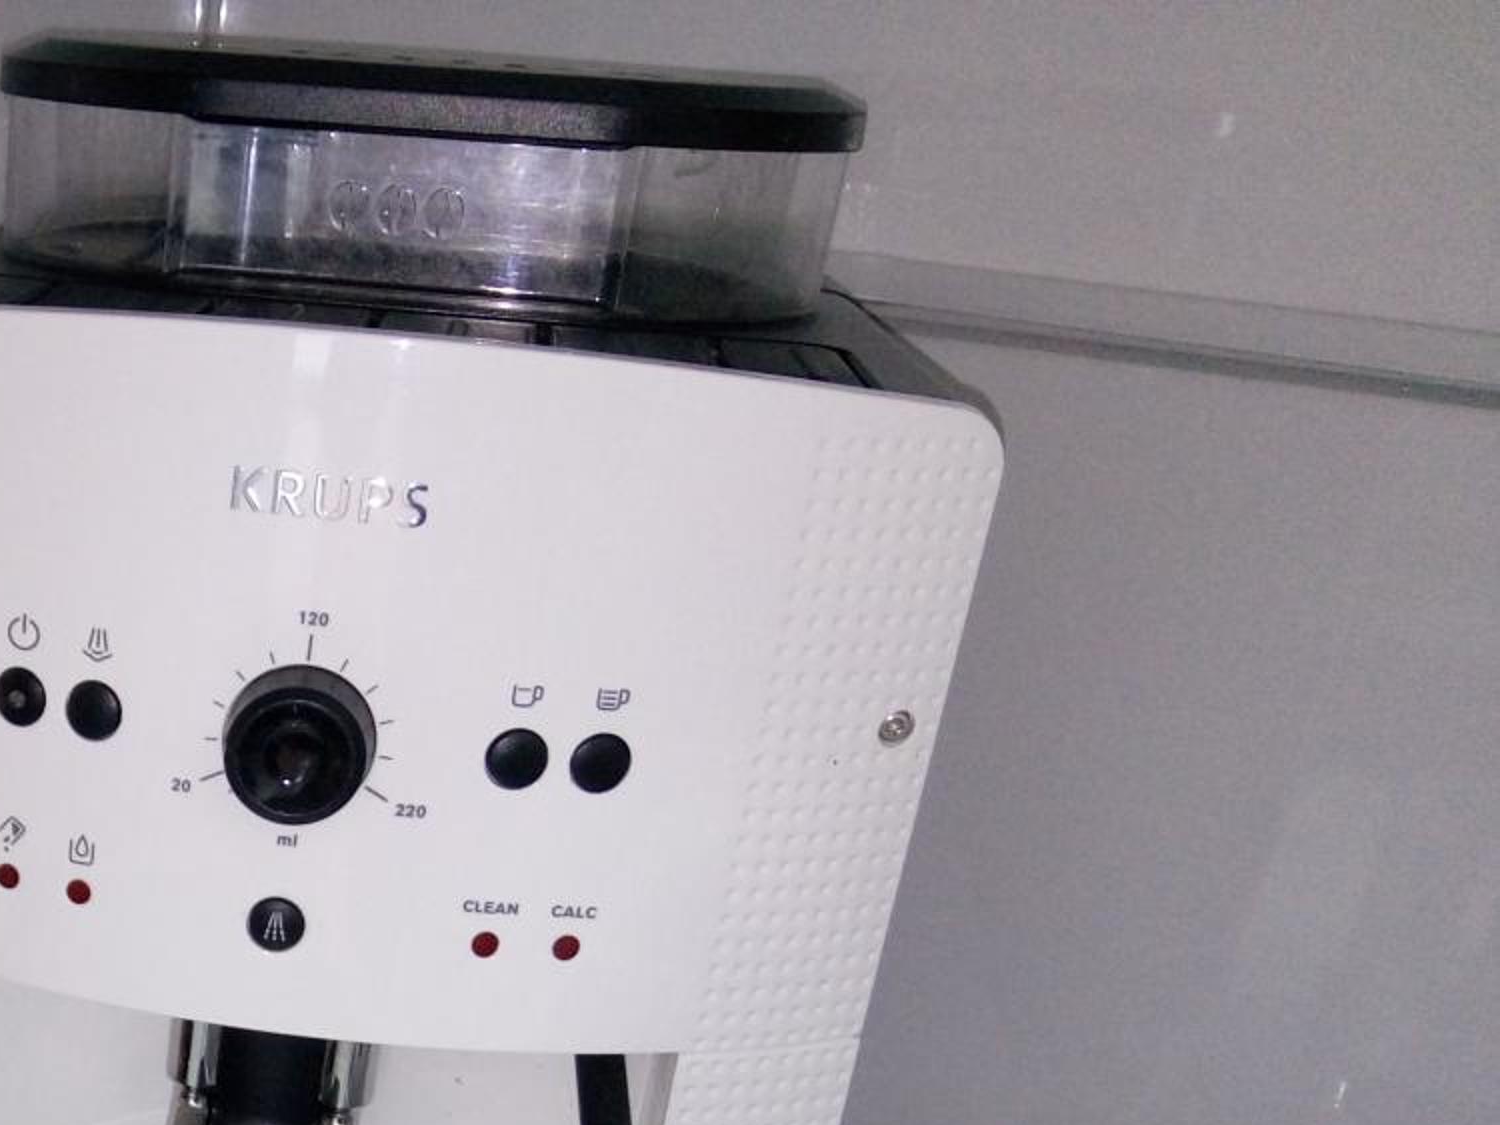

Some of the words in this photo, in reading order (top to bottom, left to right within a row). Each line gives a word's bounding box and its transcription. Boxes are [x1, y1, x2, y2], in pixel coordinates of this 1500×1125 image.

[228, 464, 430, 529] KRUPS
[299, 611, 329, 627] 120
[171, 778, 192, 793] 20
[394, 803, 427, 820] 220
[276, 832, 298, 848] ml
[462, 900, 520, 916] CLEAN
[550, 903, 598, 920] CALC
